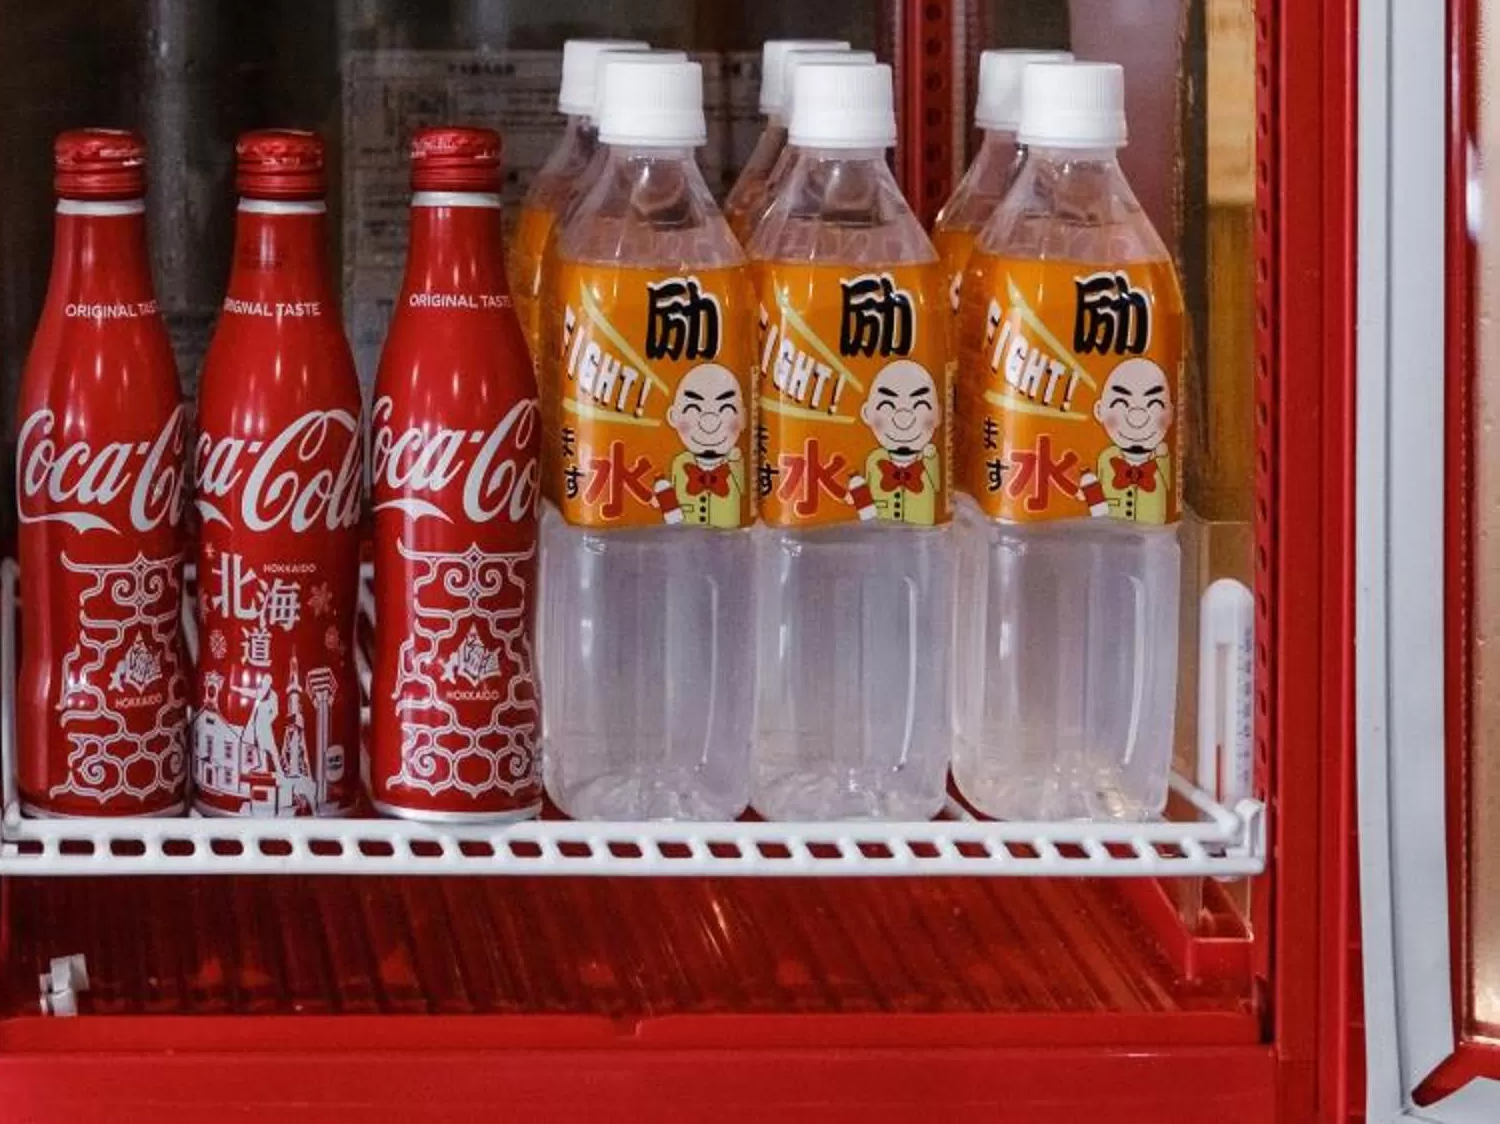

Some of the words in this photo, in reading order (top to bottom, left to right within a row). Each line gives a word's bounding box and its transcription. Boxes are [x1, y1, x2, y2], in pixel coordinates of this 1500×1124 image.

[409, 292, 478, 309] ORIGINAL
[65, 303, 137, 318] ORIGINAL
[275, 302, 321, 317] TASTE
[583, 440, 654, 520] 水
[776, 437, 851, 516] 水
[1007, 434, 1081, 512] 水
[263, 563, 317, 574] HOKKAIDO
[211, 552, 301, 667] 北海道
[446, 689, 501, 701] HOKKAIDO
